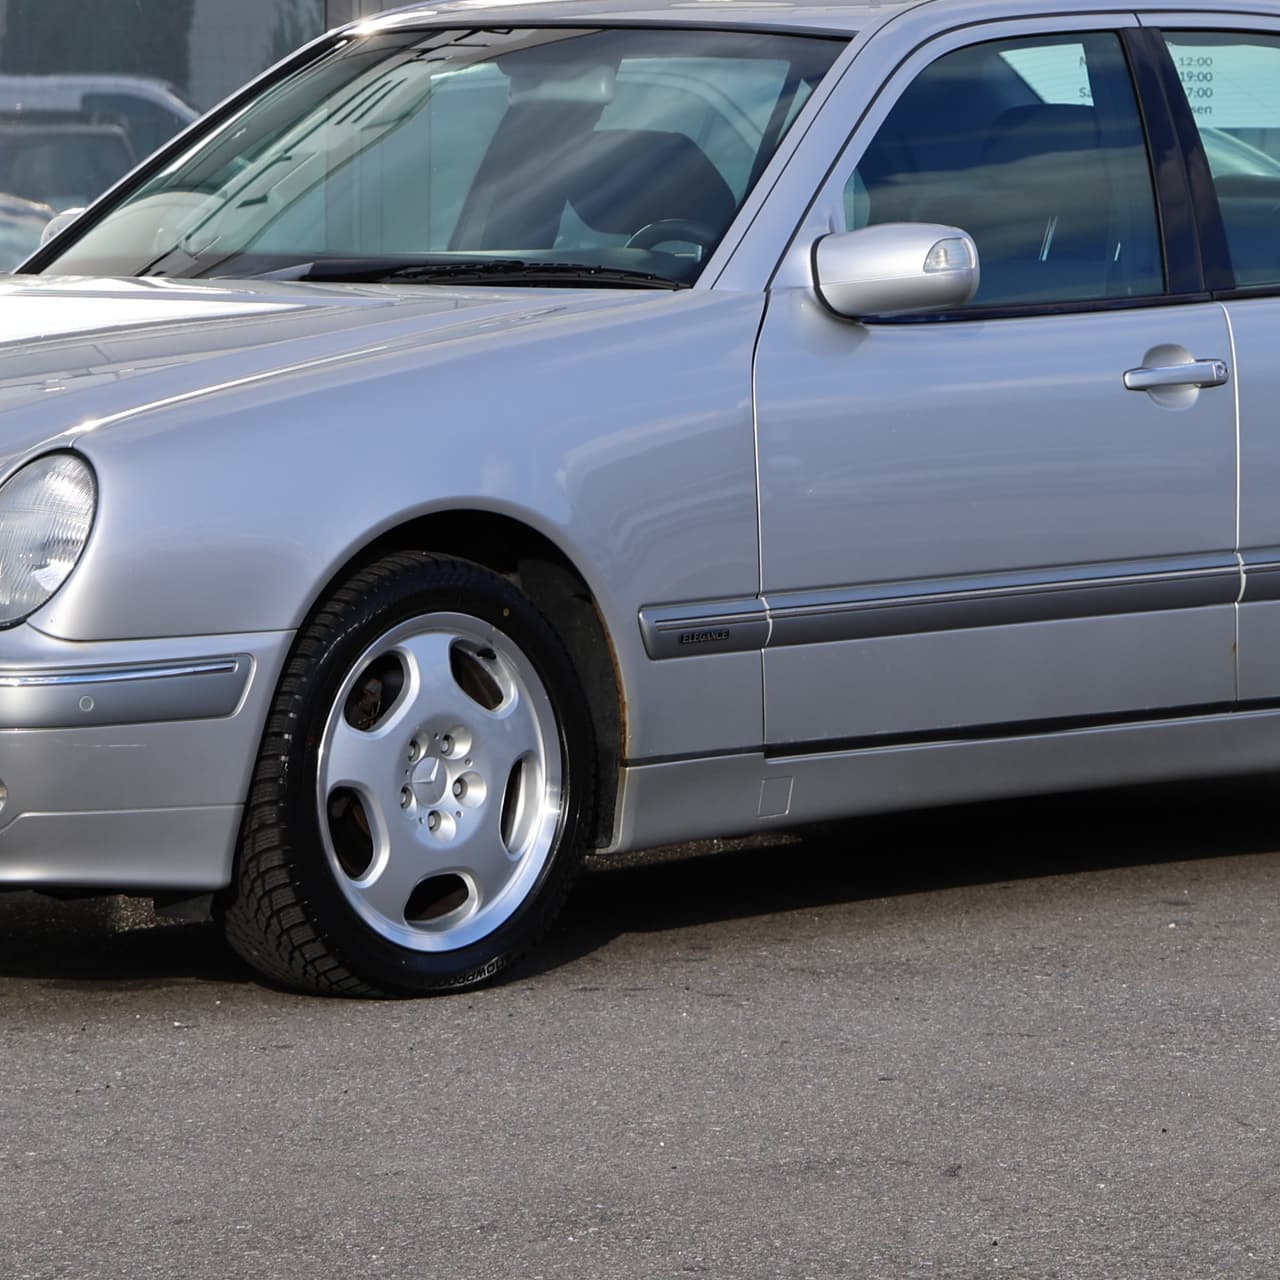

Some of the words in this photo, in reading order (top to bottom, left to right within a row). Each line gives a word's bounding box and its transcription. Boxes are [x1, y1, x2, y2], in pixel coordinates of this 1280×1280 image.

[1178, 56, 1213, 67] 12:00
[1187, 87, 1213, 98] 7:00
[682, 631, 728, 643] ELEGANCE
